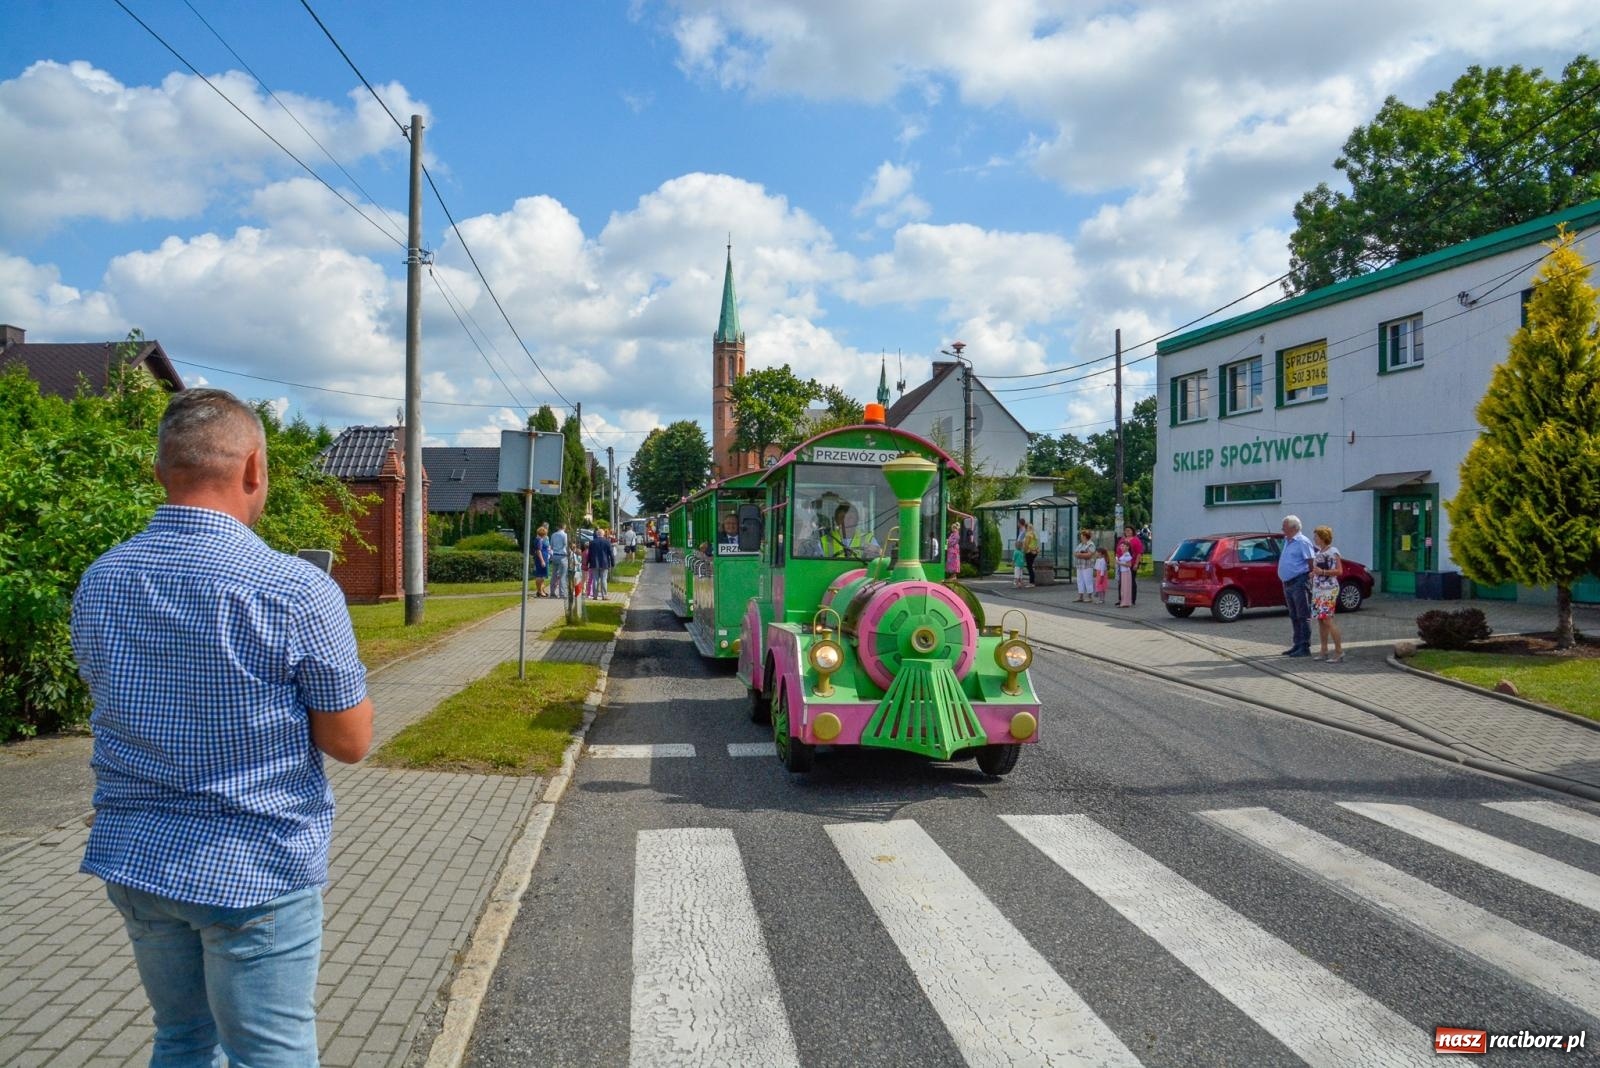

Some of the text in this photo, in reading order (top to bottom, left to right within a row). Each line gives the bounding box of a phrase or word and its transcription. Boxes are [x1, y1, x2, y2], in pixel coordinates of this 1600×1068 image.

[816, 450, 875, 462] PRZEWÓZ
[1173, 432, 1329, 472] SKLEP SPOŻYWCZY
